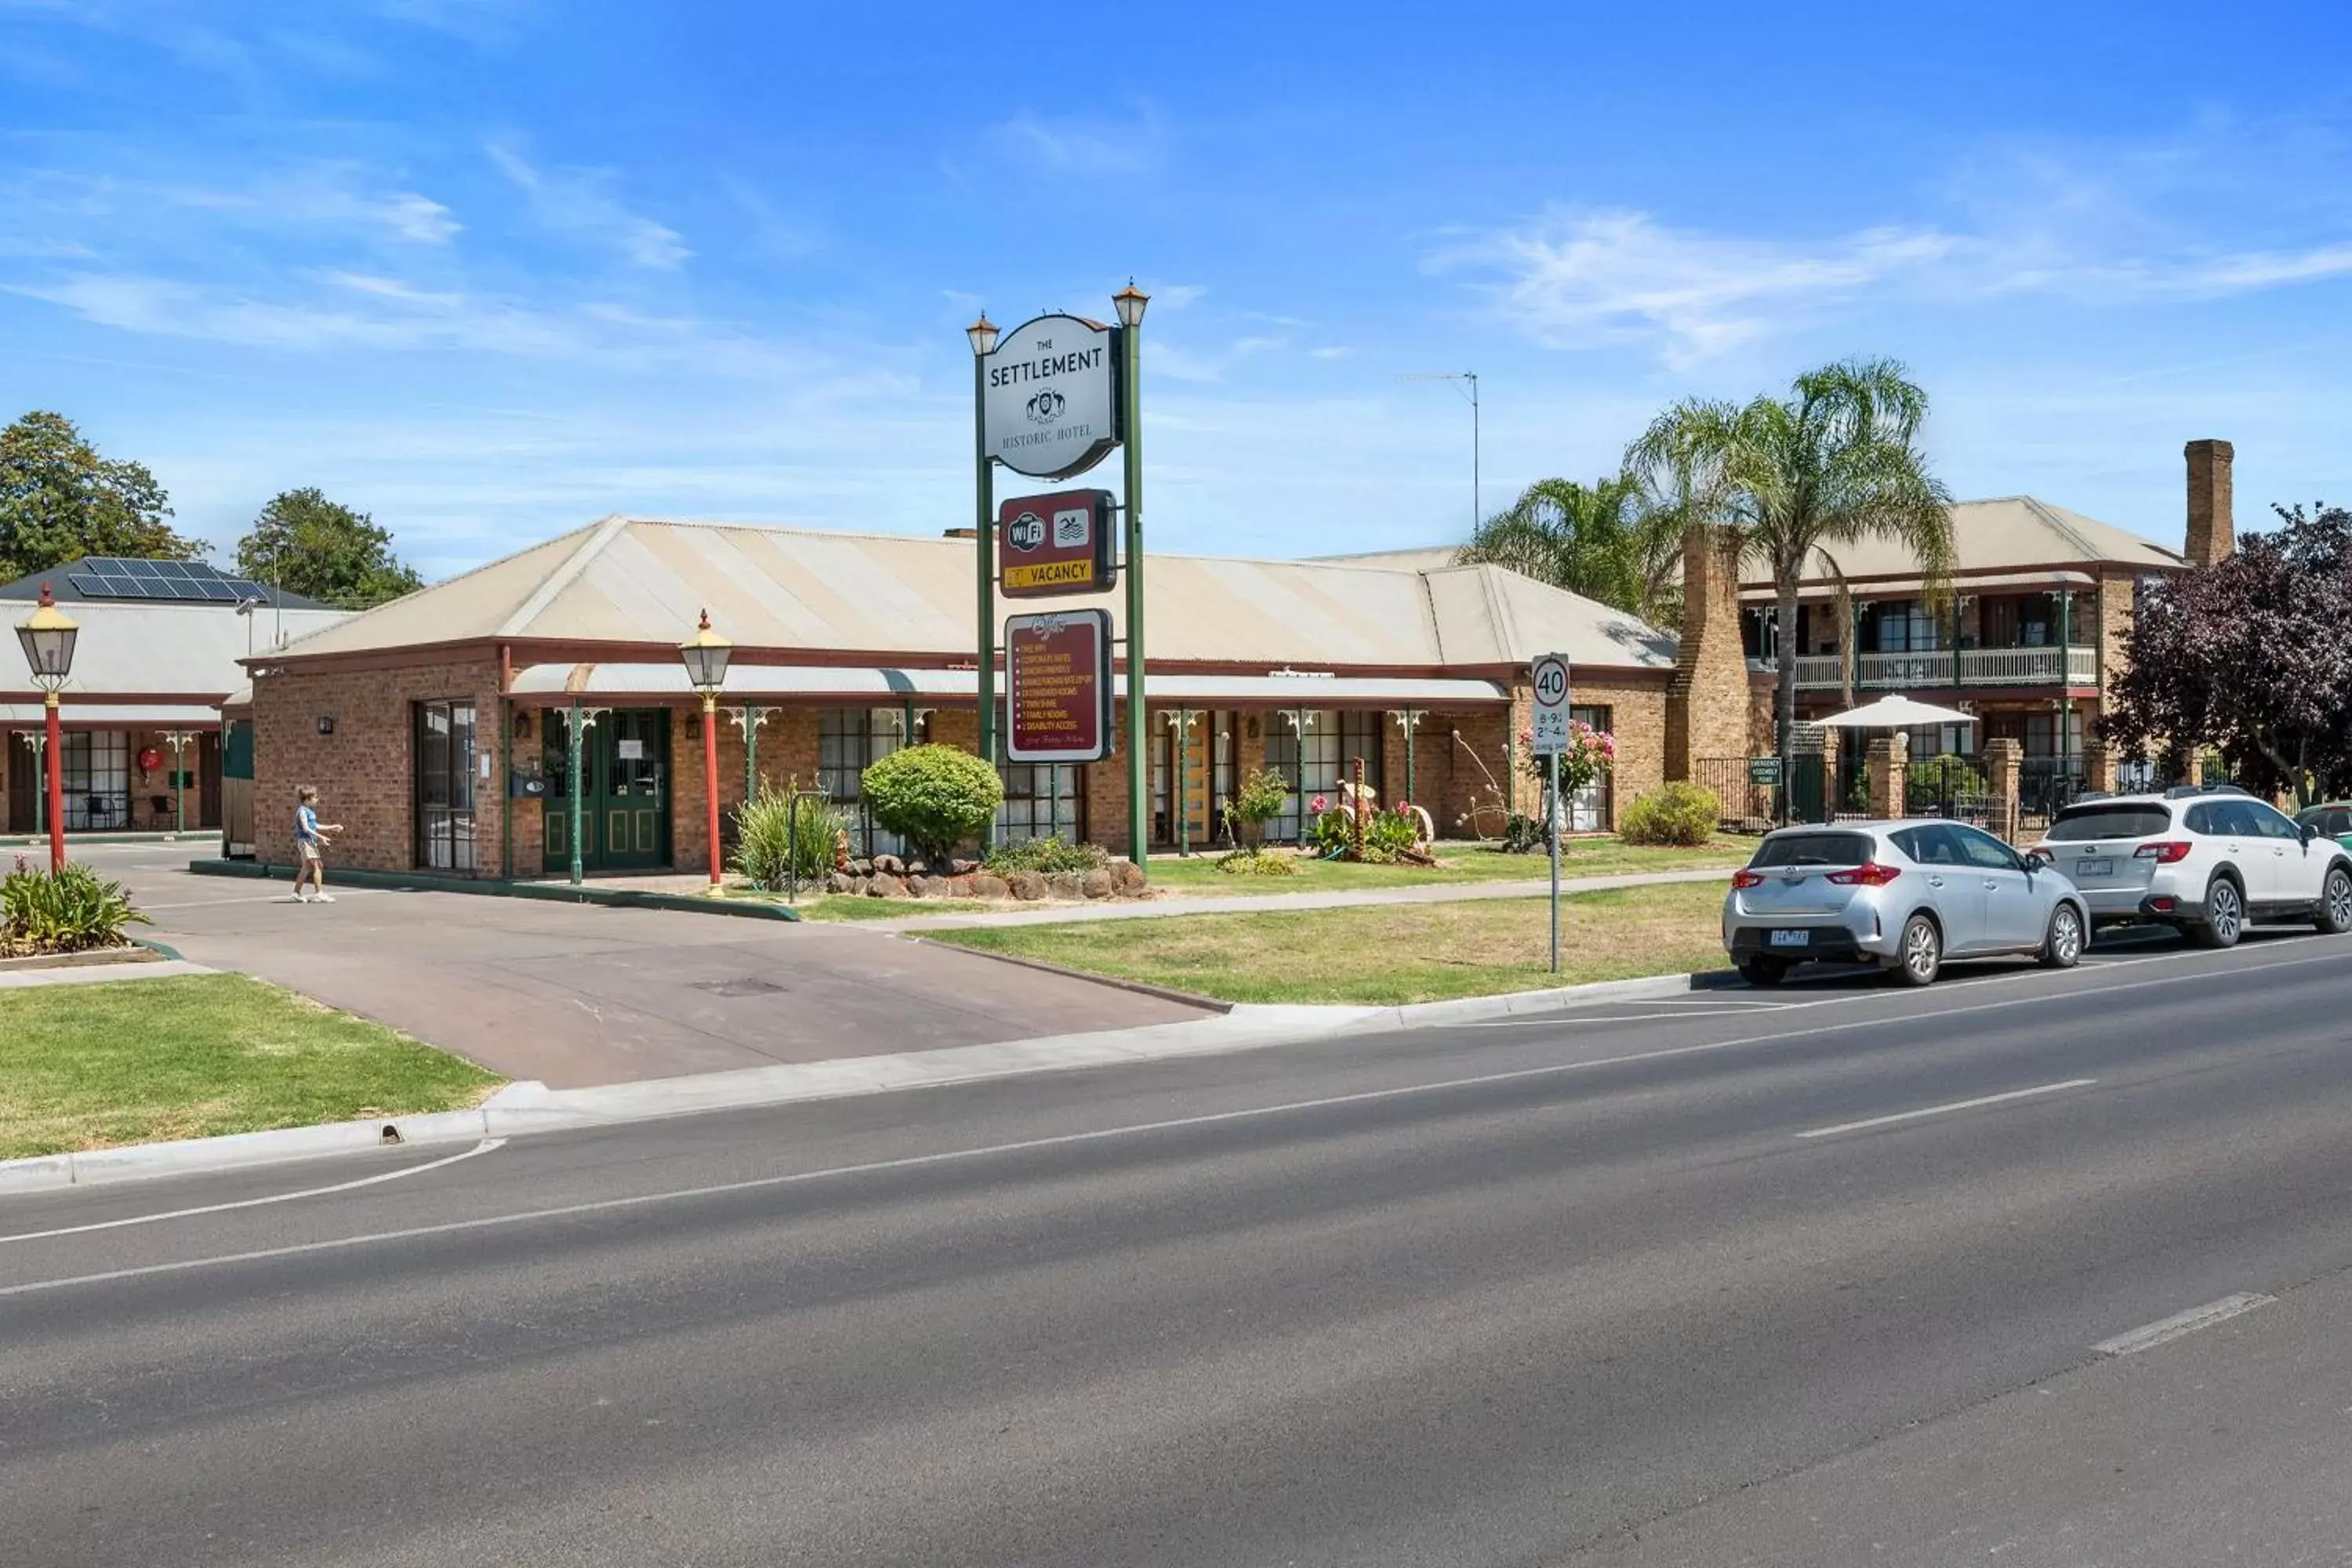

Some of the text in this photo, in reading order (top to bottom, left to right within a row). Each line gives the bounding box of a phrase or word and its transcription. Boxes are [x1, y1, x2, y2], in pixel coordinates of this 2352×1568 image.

[1037, 339, 1052, 351] THE
[990, 347, 1102, 387] SETTLEMENT
[1003, 424, 1091, 449] HISTORIC HOTEL
[1031, 563, 1087, 583] VACANCY
[1538, 670, 1563, 695] 40
